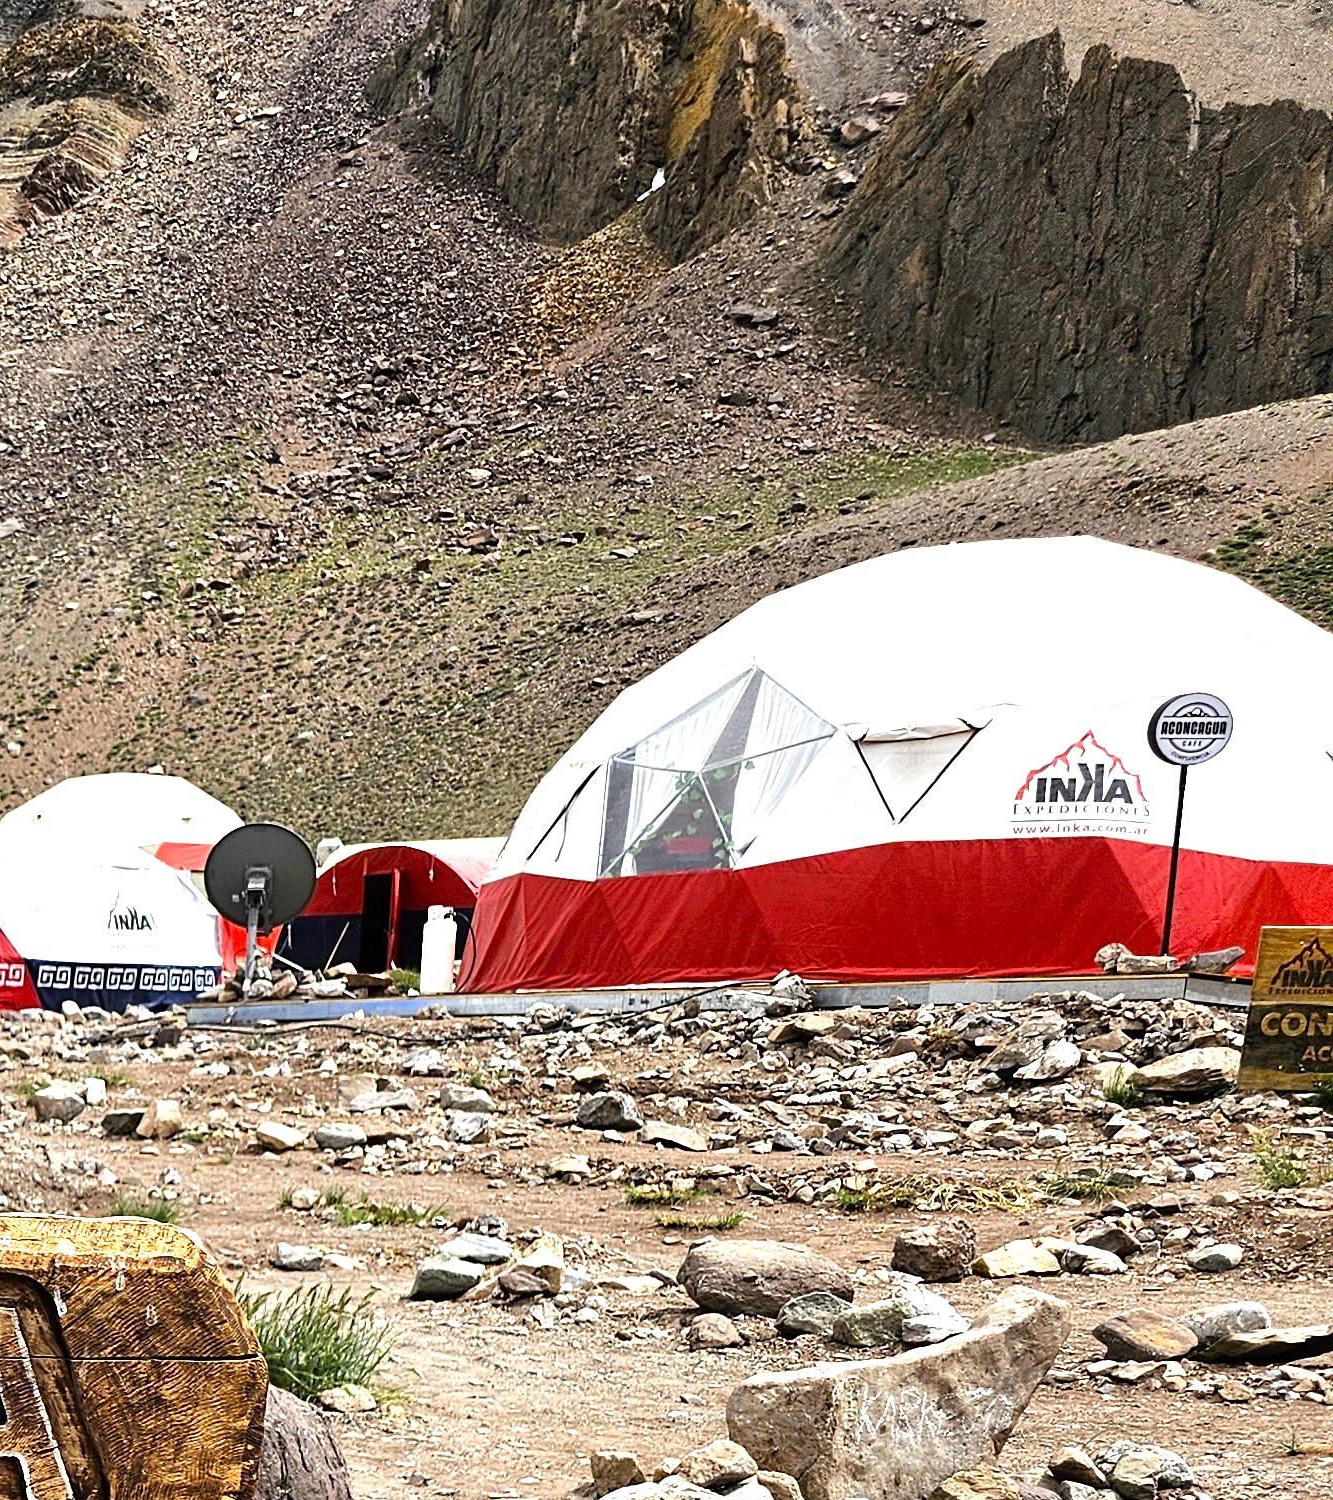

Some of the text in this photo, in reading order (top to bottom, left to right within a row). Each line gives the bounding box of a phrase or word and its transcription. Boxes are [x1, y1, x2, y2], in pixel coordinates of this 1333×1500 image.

[1160, 720, 1228, 736] ACONCAGUA
[1035, 762, 1133, 804] INKA
[1301, 1045, 1333, 1062] AC
